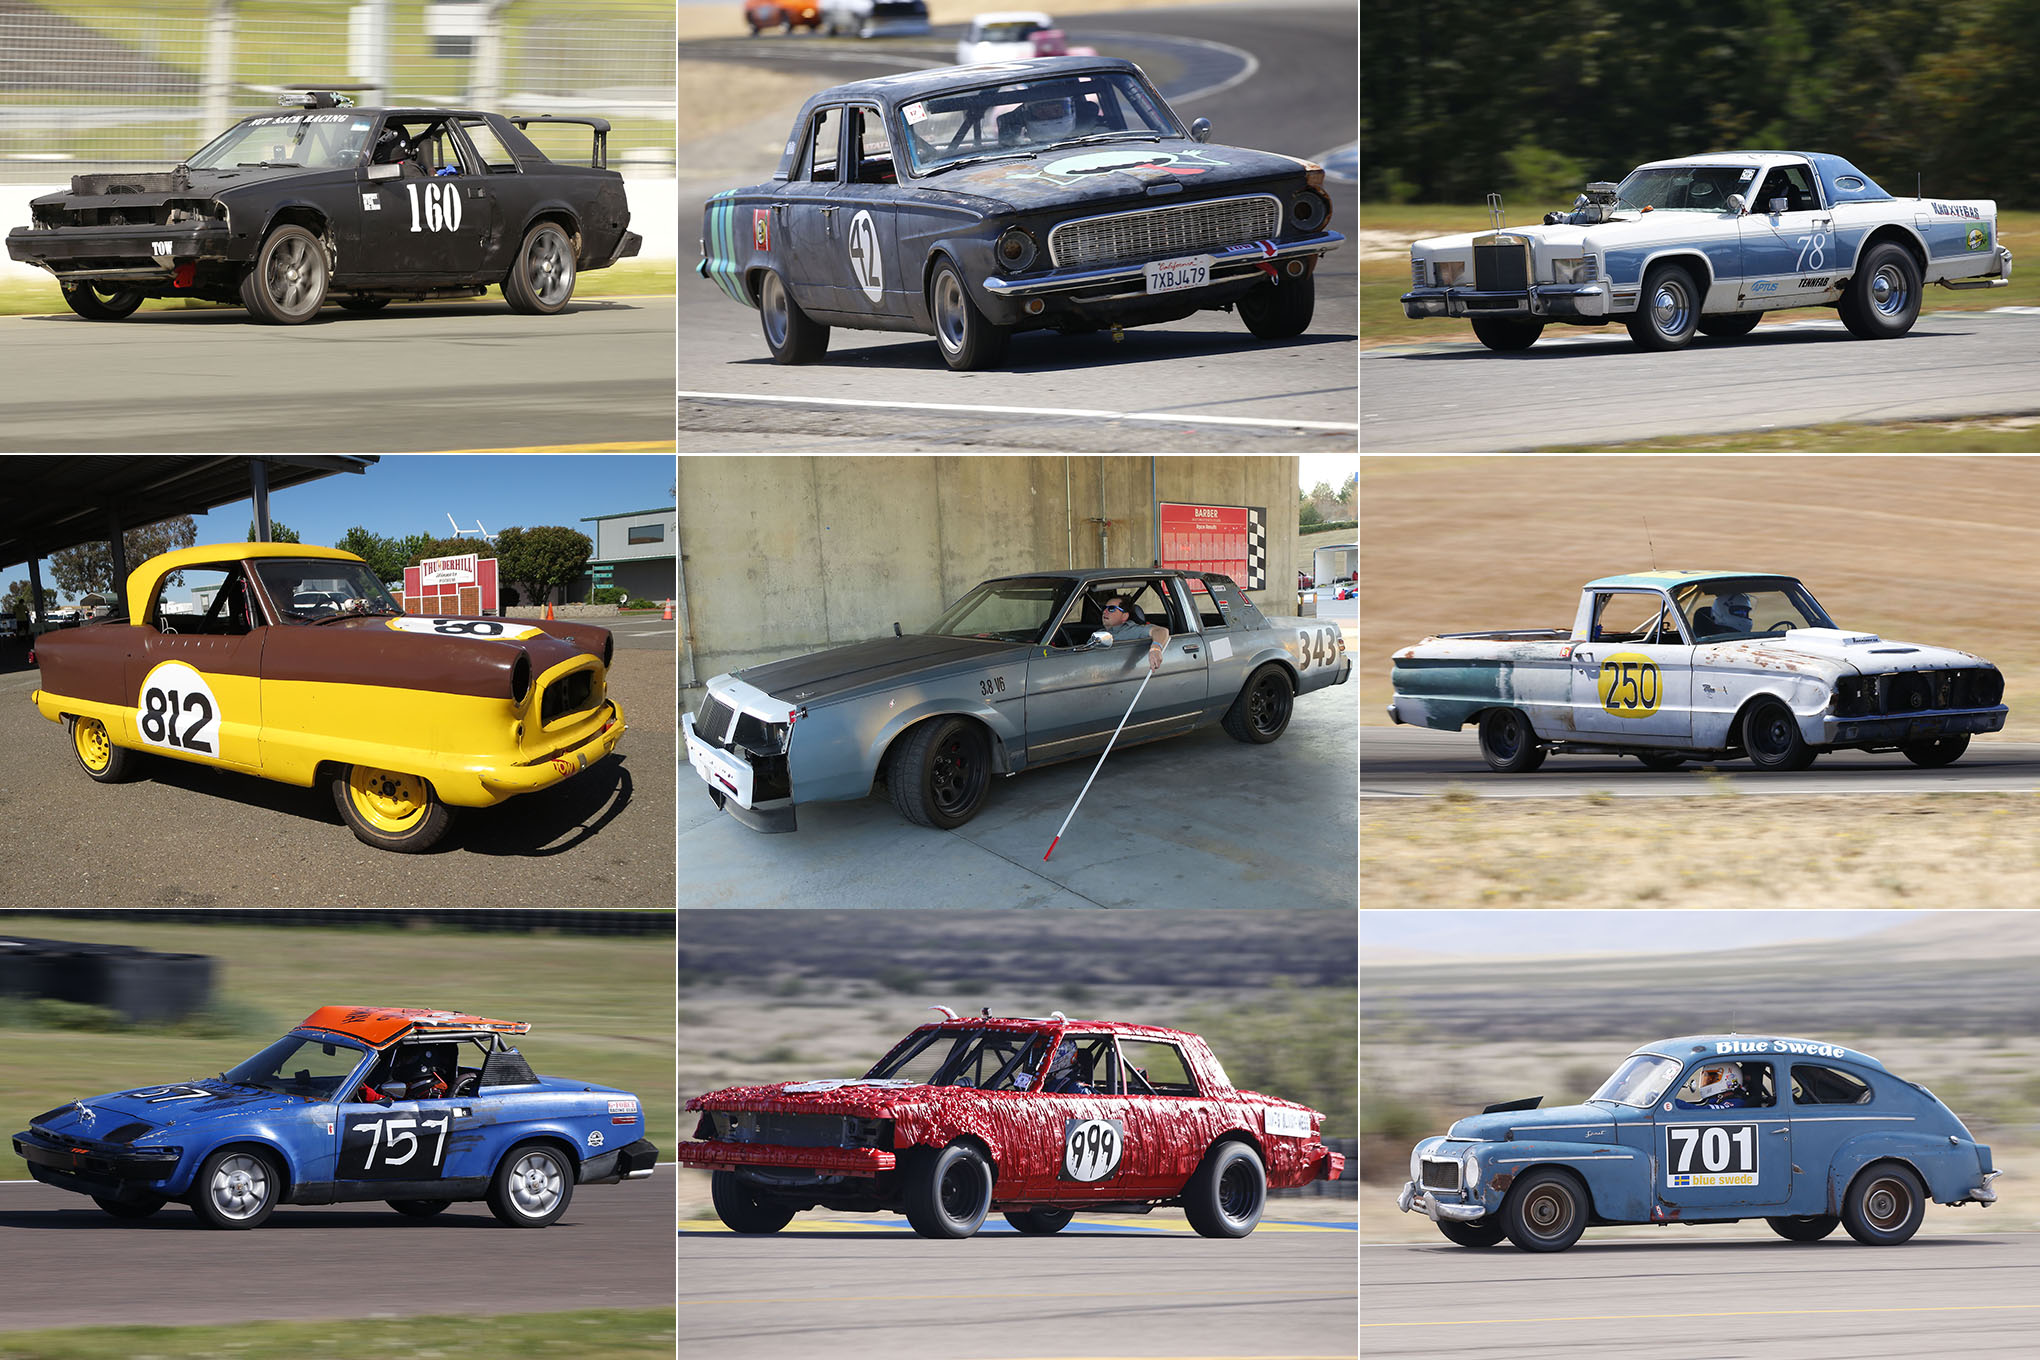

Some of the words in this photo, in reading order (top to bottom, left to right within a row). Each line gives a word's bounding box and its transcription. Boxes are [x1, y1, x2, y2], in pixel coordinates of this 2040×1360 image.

[248, 117, 273, 126] NUT
[272, 115, 304, 124] SACK
[303, 114, 349, 123] RACING
[406, 182, 462, 233] 160
[151, 241, 173, 256] TOW
[851, 218, 880, 287] 42
[1796, 233, 1826, 272] 78
[1151, 267, 1206, 289] 7XBJ479
[1159, 261, 1197, 271] California
[1798, 278, 1830, 288] TENNFAB
[1194, 508, 1219, 518] BARBER
[1299, 627, 1336, 671] 343
[980, 680, 994, 696] 3.8
[994, 676, 1006, 692] V6
[1604, 662, 1657, 709] 250
[142, 687, 213, 753] 812
[1715, 1040, 1769, 1054] Blue
[1773, 1040, 1845, 1058] Swede
[352, 1116, 448, 1170] 757
[1071, 1124, 1114, 1178] 999
[1671, 1127, 1752, 1172] 701
[1692, 1175, 1716, 1185] blue
[1719, 1174, 1753, 1184] swede
